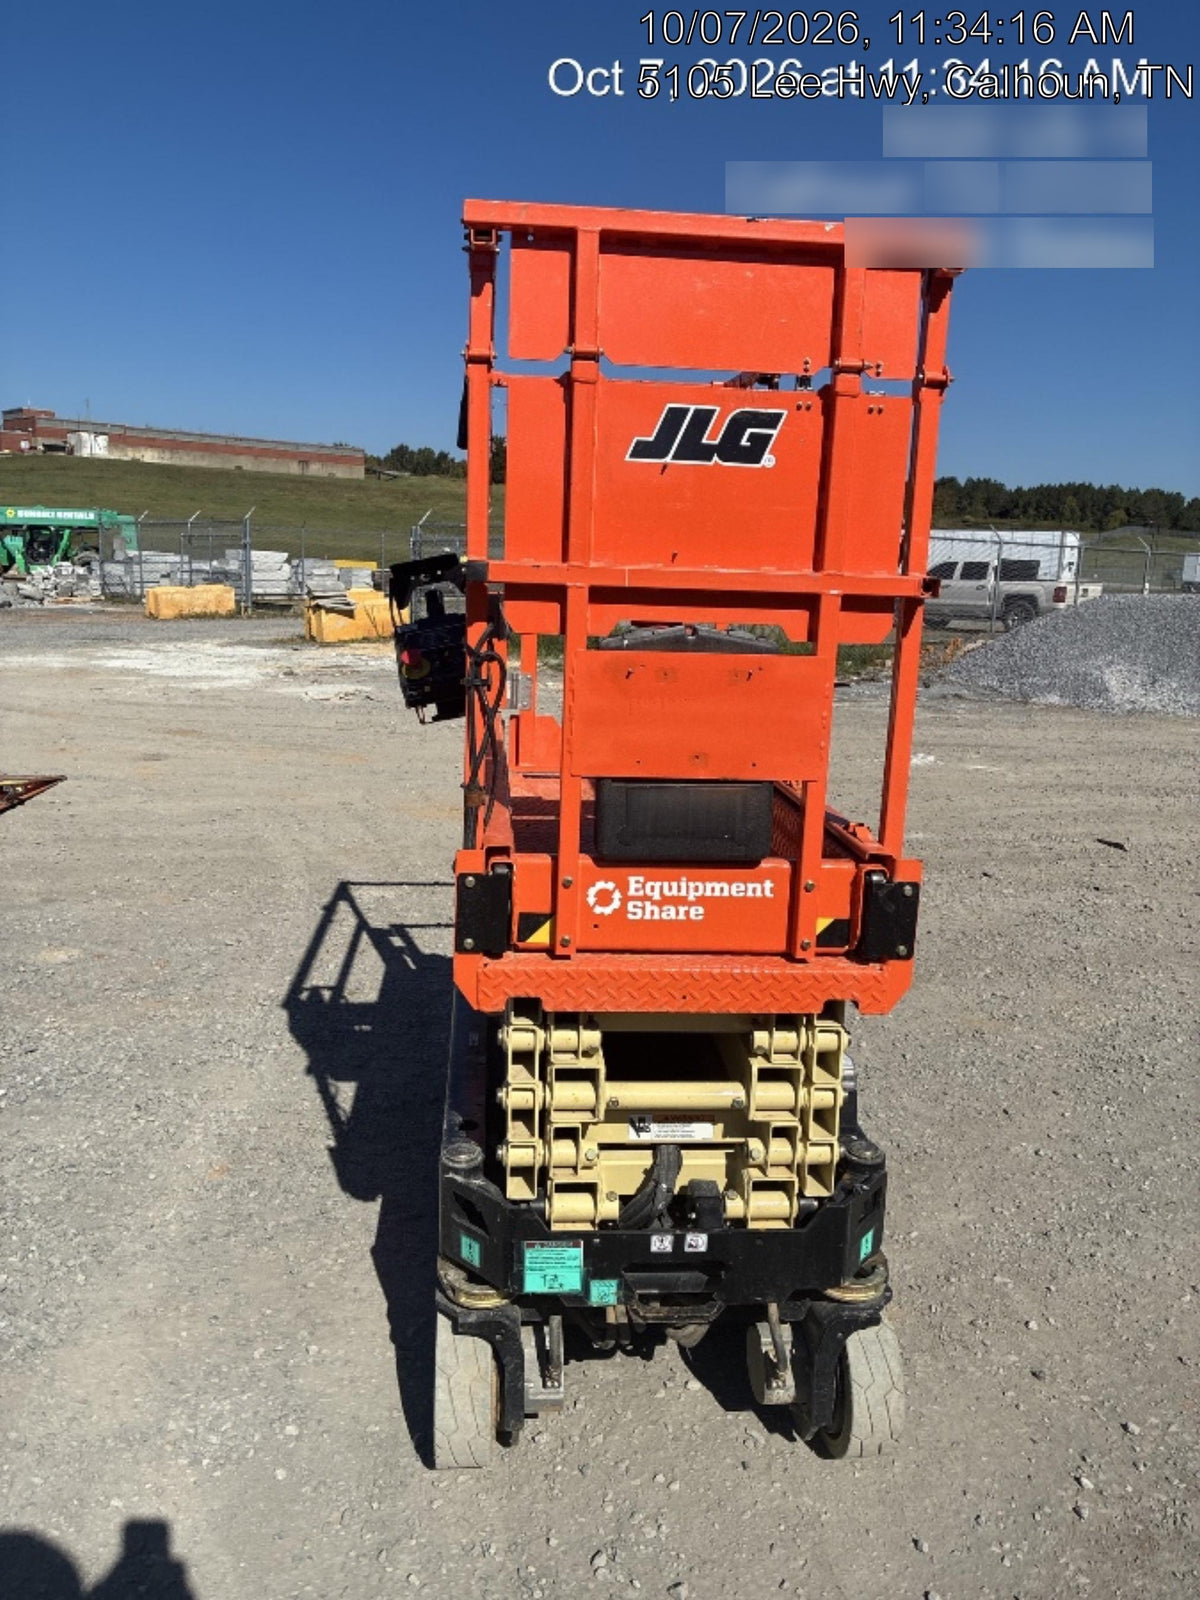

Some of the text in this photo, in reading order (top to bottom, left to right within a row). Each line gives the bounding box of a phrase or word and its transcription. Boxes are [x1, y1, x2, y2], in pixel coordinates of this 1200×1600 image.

[624, 403, 788, 468] JLG
[627, 876, 775, 901] Equipment
[626, 901, 705, 920] Share
